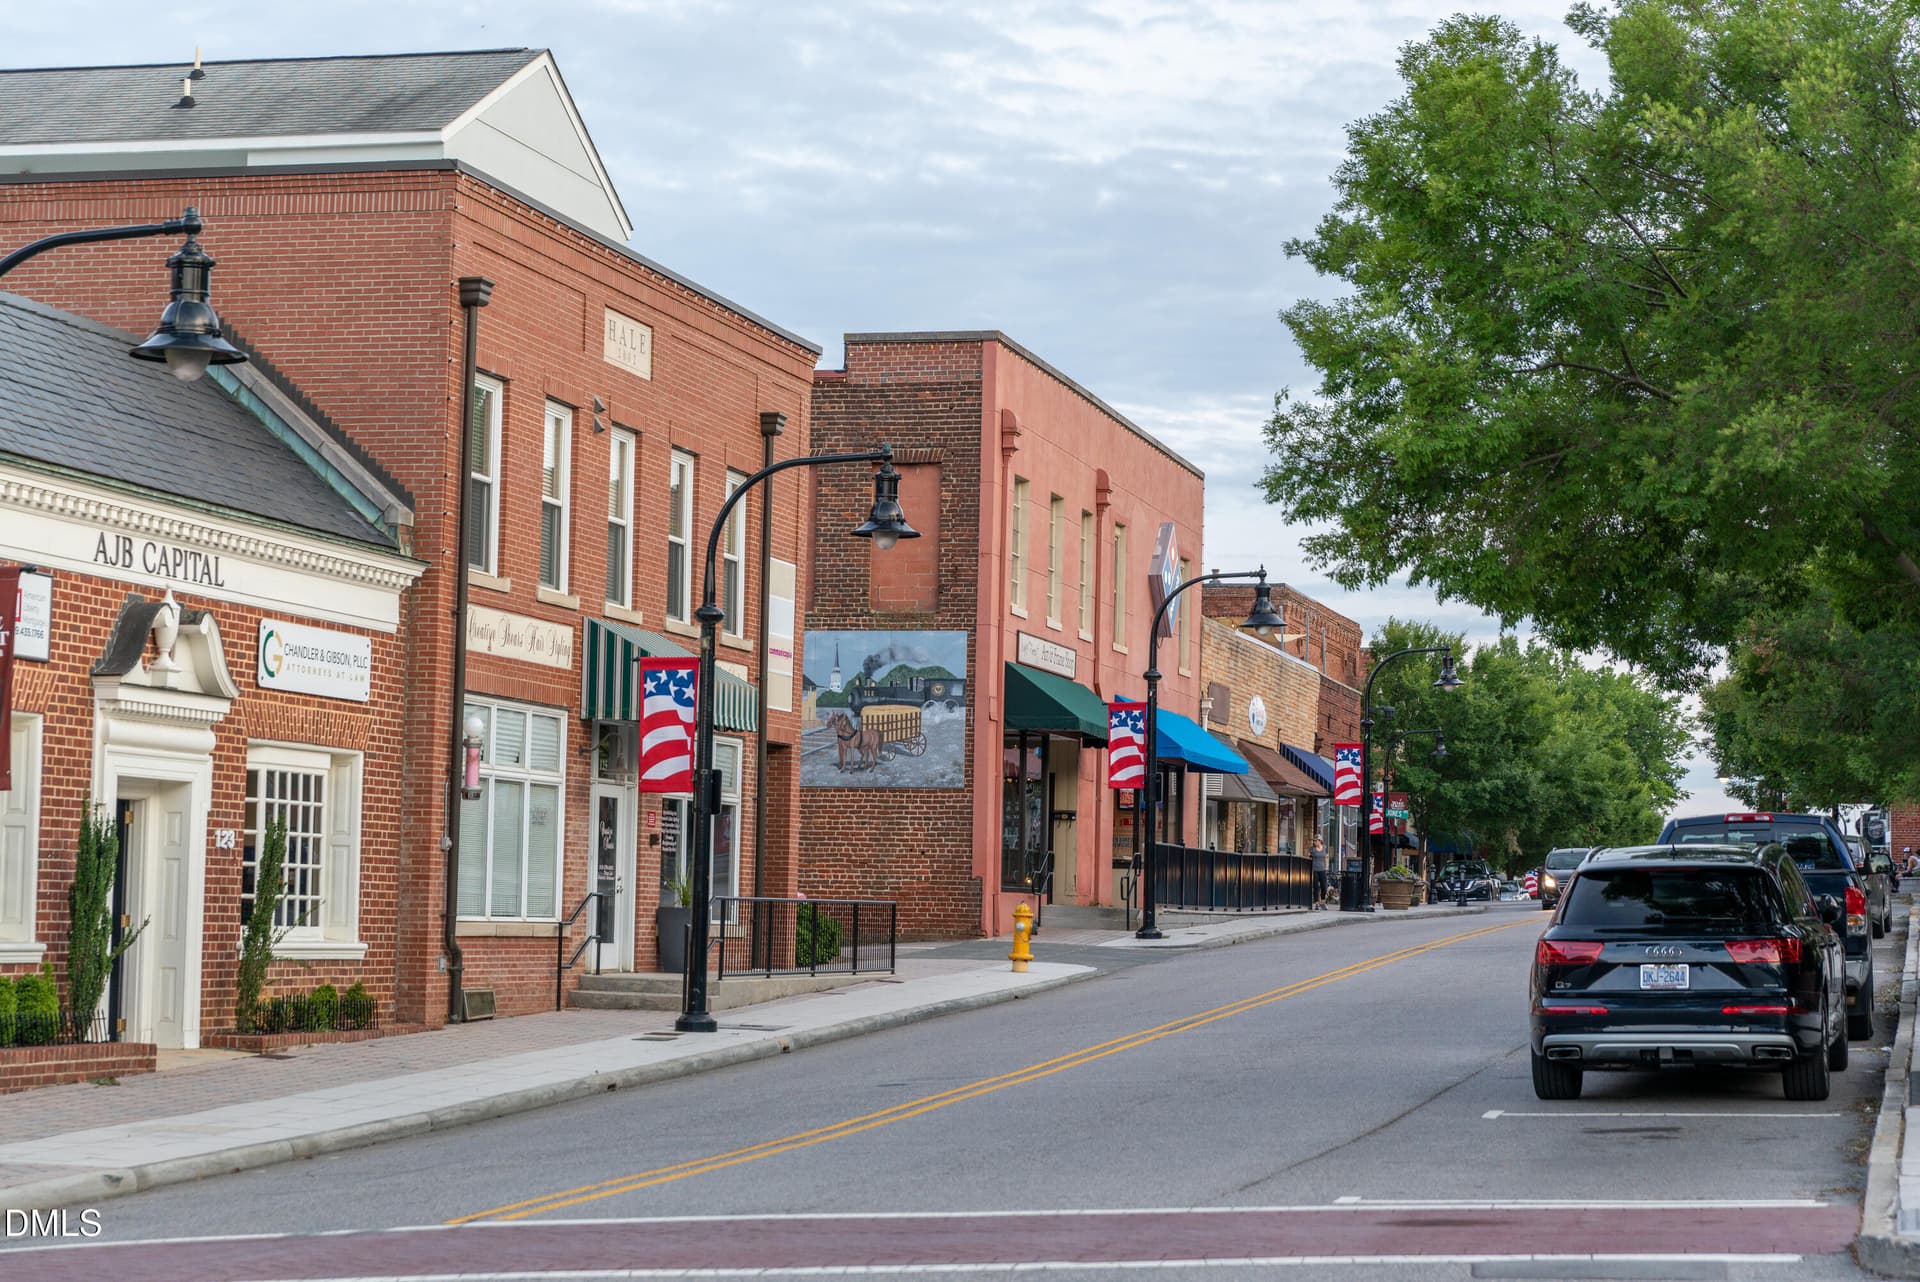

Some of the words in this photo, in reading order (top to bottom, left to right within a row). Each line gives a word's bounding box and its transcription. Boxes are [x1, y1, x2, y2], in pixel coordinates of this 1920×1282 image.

[608, 319, 647, 355] HALE
[94, 531, 134, 568] AJB
[142, 541, 225, 587] CAPITAL
[284, 643, 319, 661] CHANDLER
[320, 649, 324, 661] &
[326, 650, 353, 667] GIBSON,
[353, 655, 368, 669] PLLC
[286, 663, 332, 678] ATTORNEYS
[336, 671, 346, 680] AT
[349, 673, 366, 683] LAW
[215, 829, 235, 849] 123
